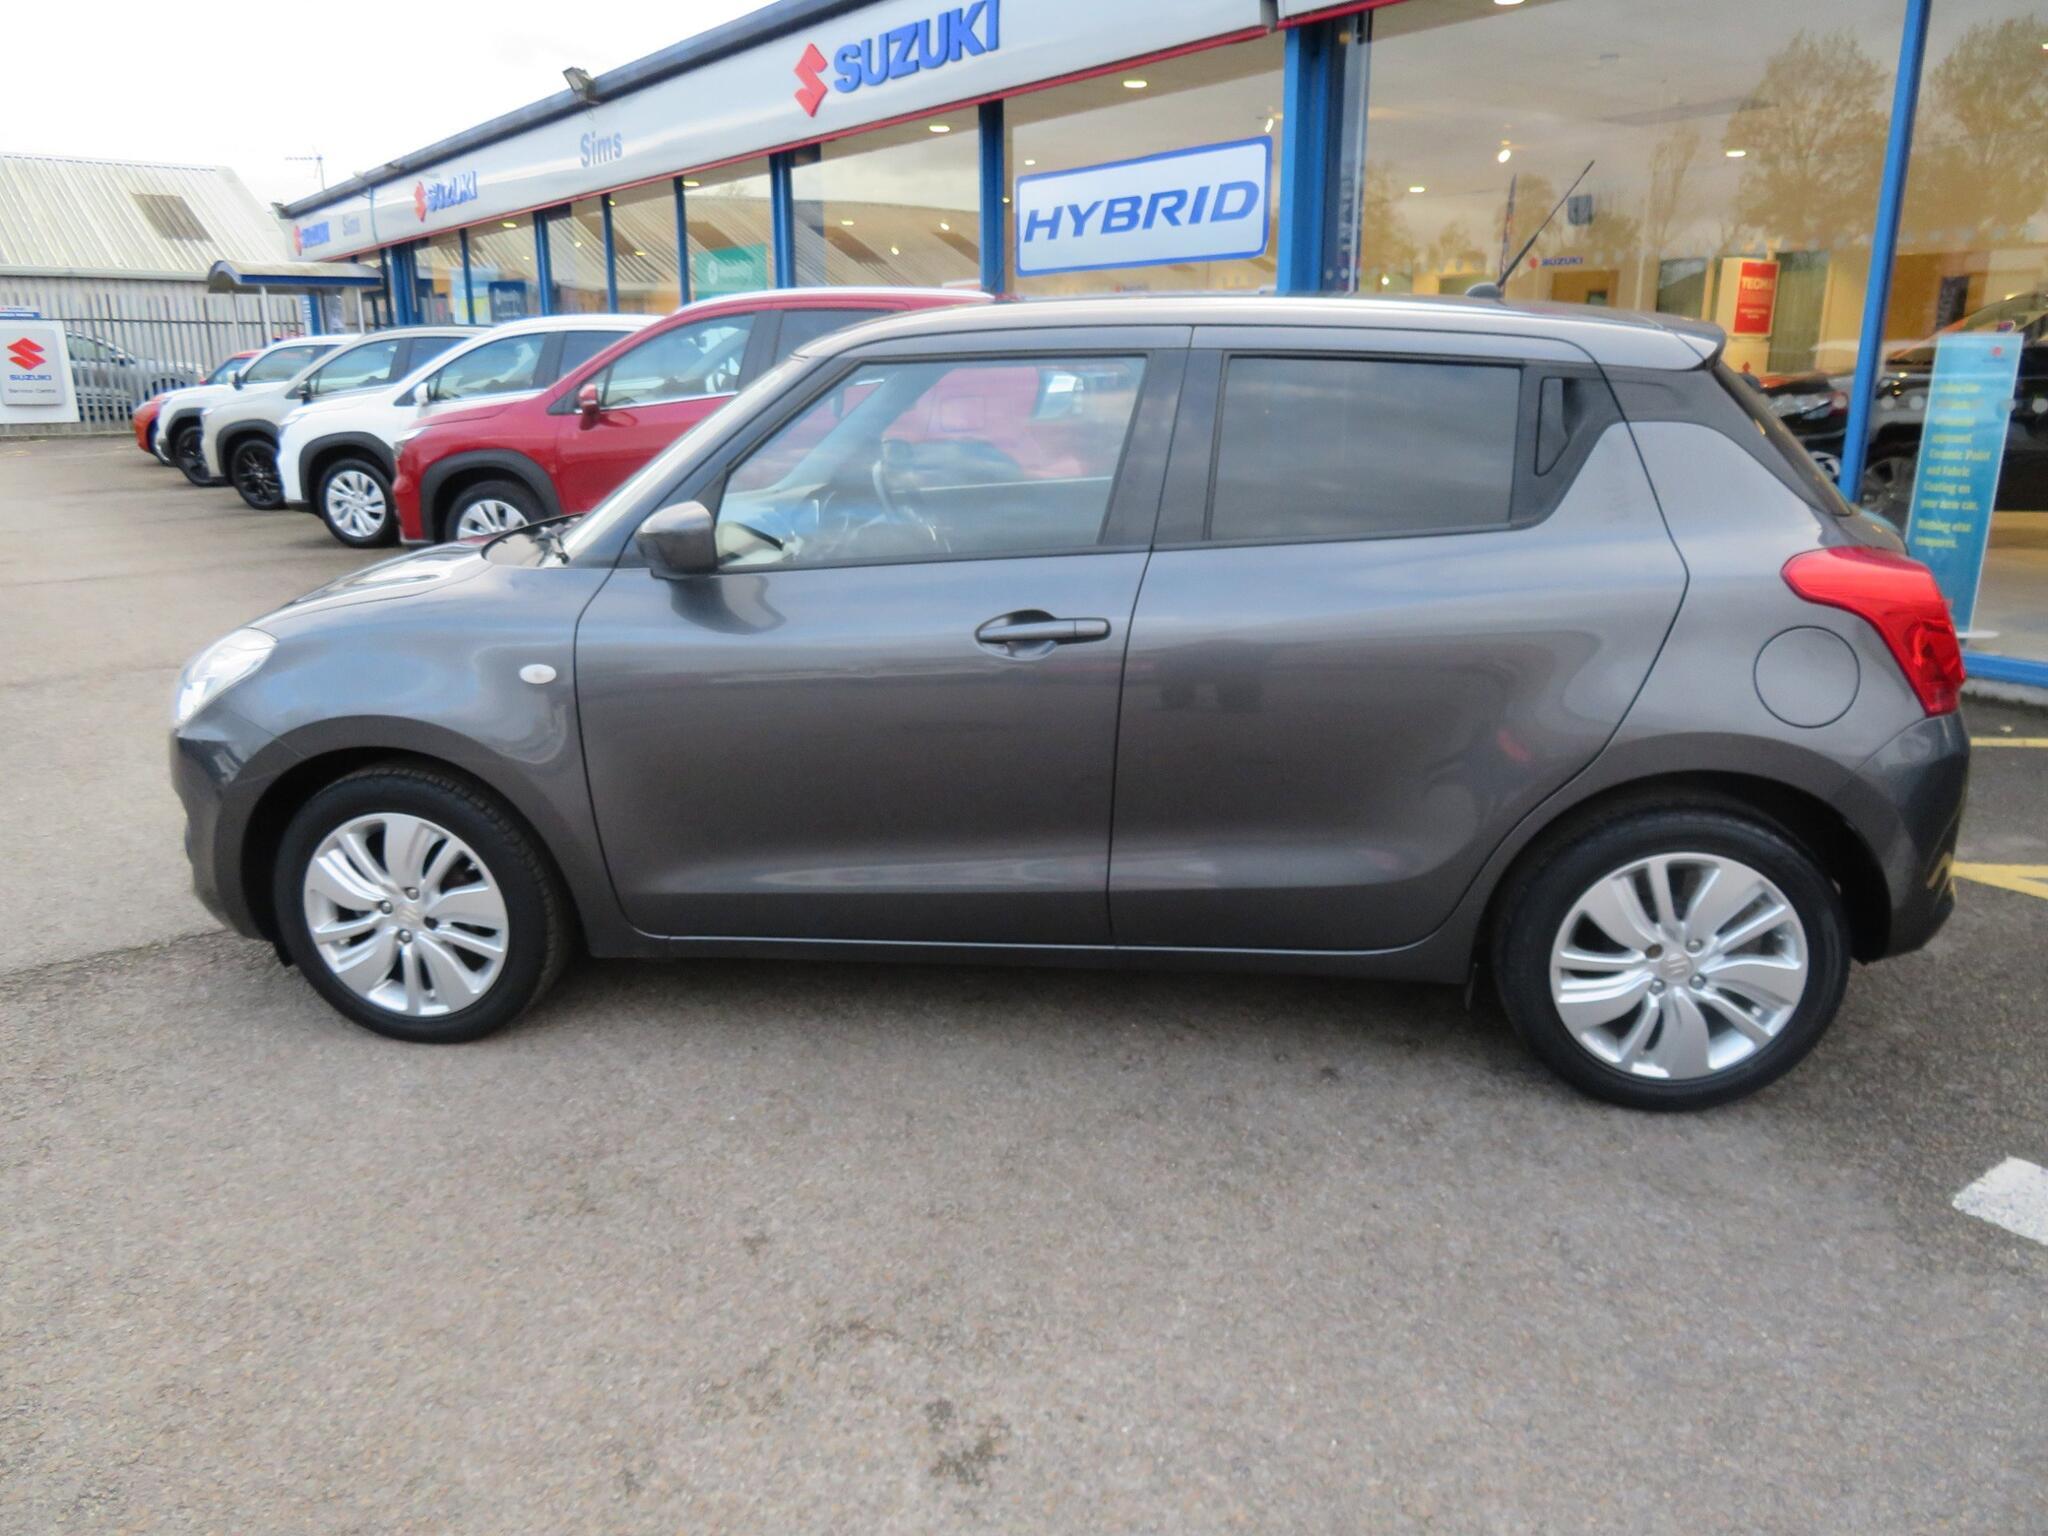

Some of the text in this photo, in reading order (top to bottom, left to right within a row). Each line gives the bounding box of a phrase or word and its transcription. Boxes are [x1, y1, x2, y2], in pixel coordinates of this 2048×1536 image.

[833, 0, 999, 93] SUZUKI
[580, 130, 622, 168] Sims
[427, 170, 477, 212] SUZUKI
[1023, 180, 1260, 243] HYBRID
[1541, 256, 1584, 267] SUZUKI
